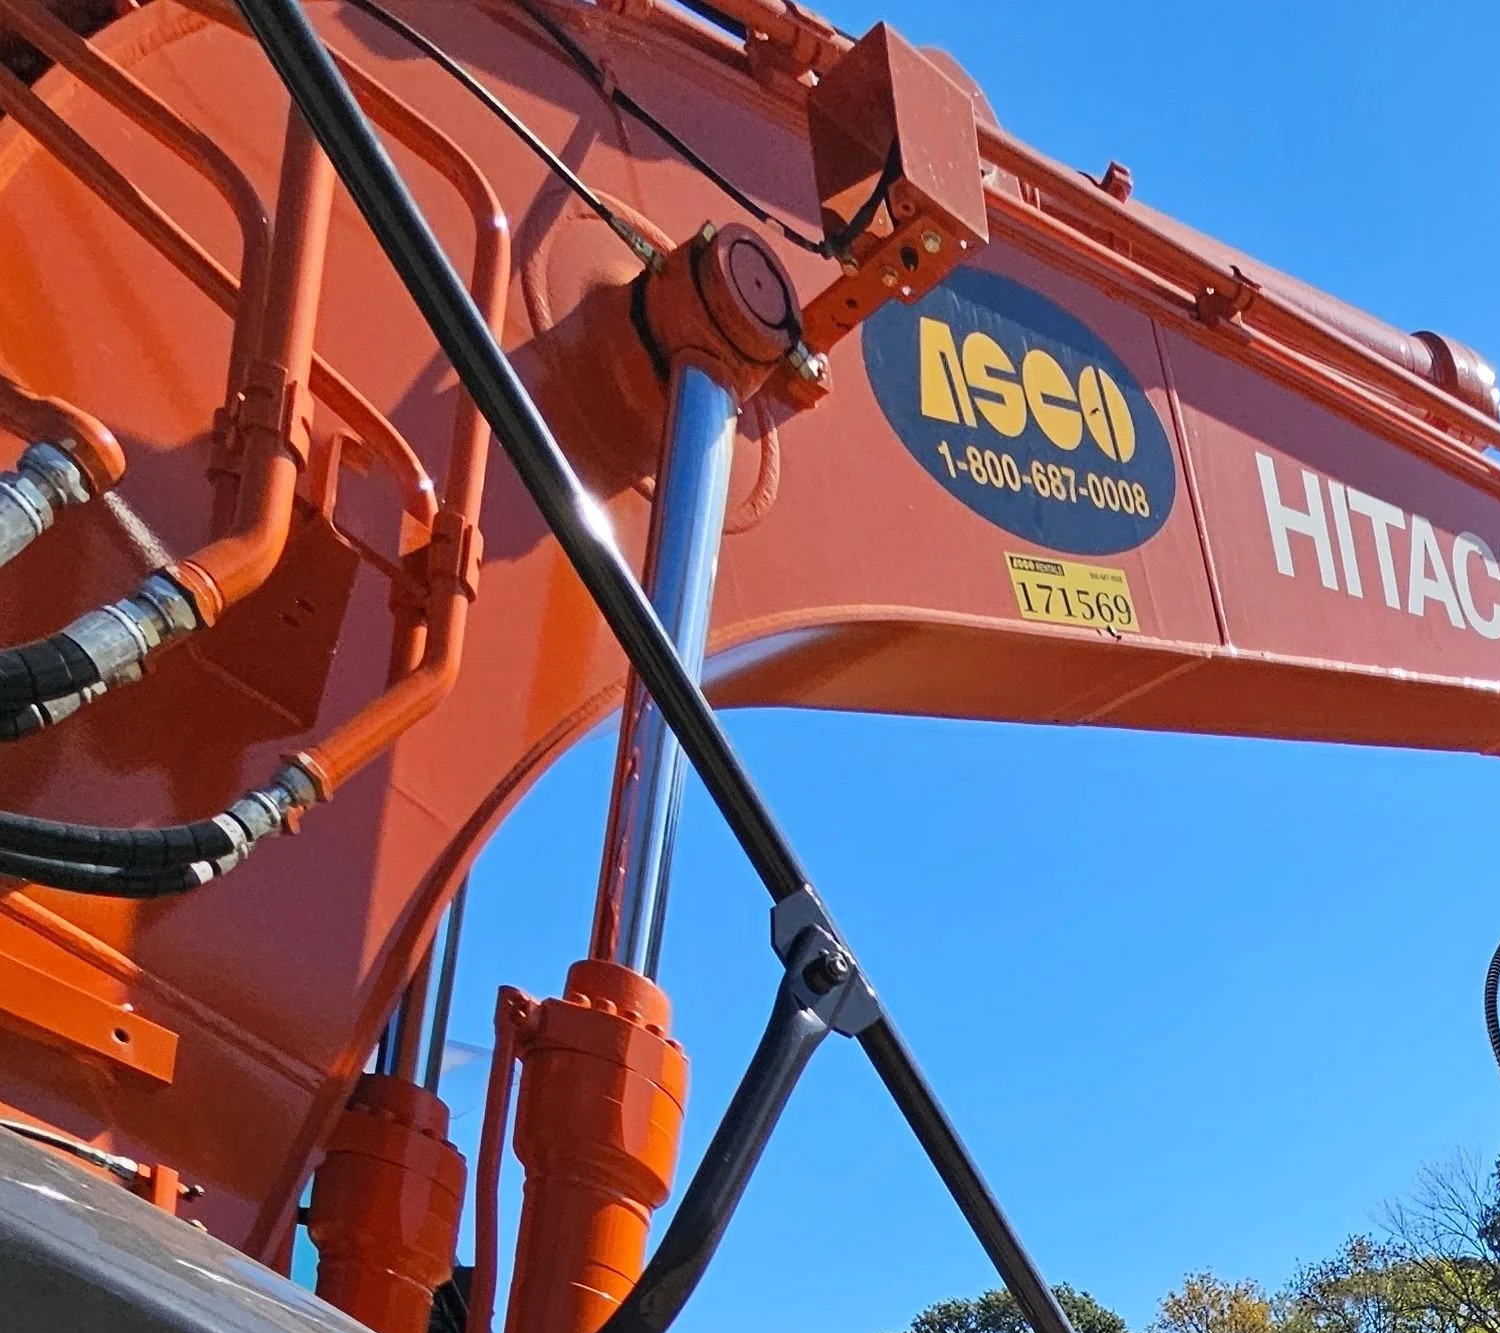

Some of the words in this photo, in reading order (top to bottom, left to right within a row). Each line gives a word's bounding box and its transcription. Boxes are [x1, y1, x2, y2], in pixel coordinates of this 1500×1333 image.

[919, 316, 1136, 464] ASCO
[937, 440, 1151, 518] 1-800-687-0008
[1017, 582, 1132, 625] 171569
